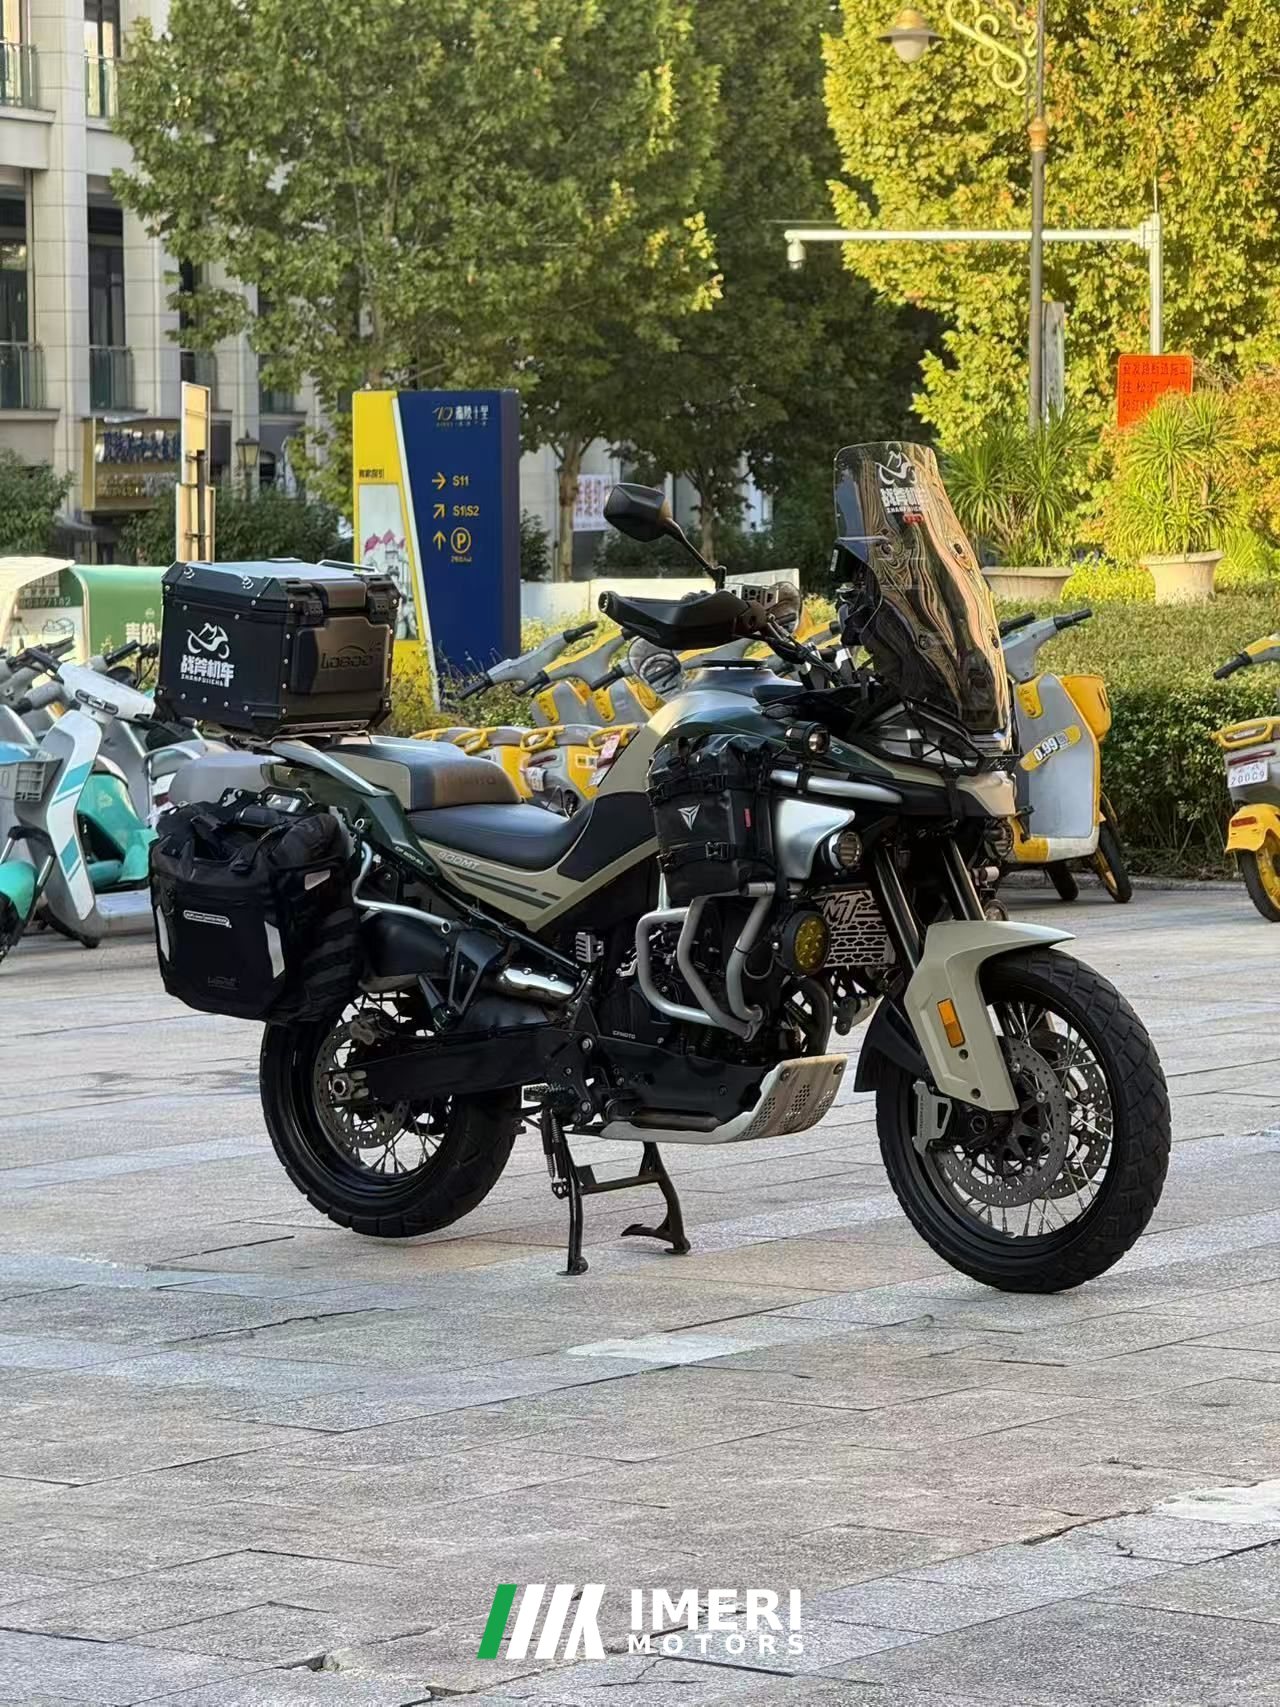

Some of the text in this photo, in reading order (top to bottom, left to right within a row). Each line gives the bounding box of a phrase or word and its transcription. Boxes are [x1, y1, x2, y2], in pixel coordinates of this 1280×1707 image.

[452, 475, 469, 487] S11
[180, 653, 235, 688] 战斧机车
[1033, 736, 1060, 761] 0.99
